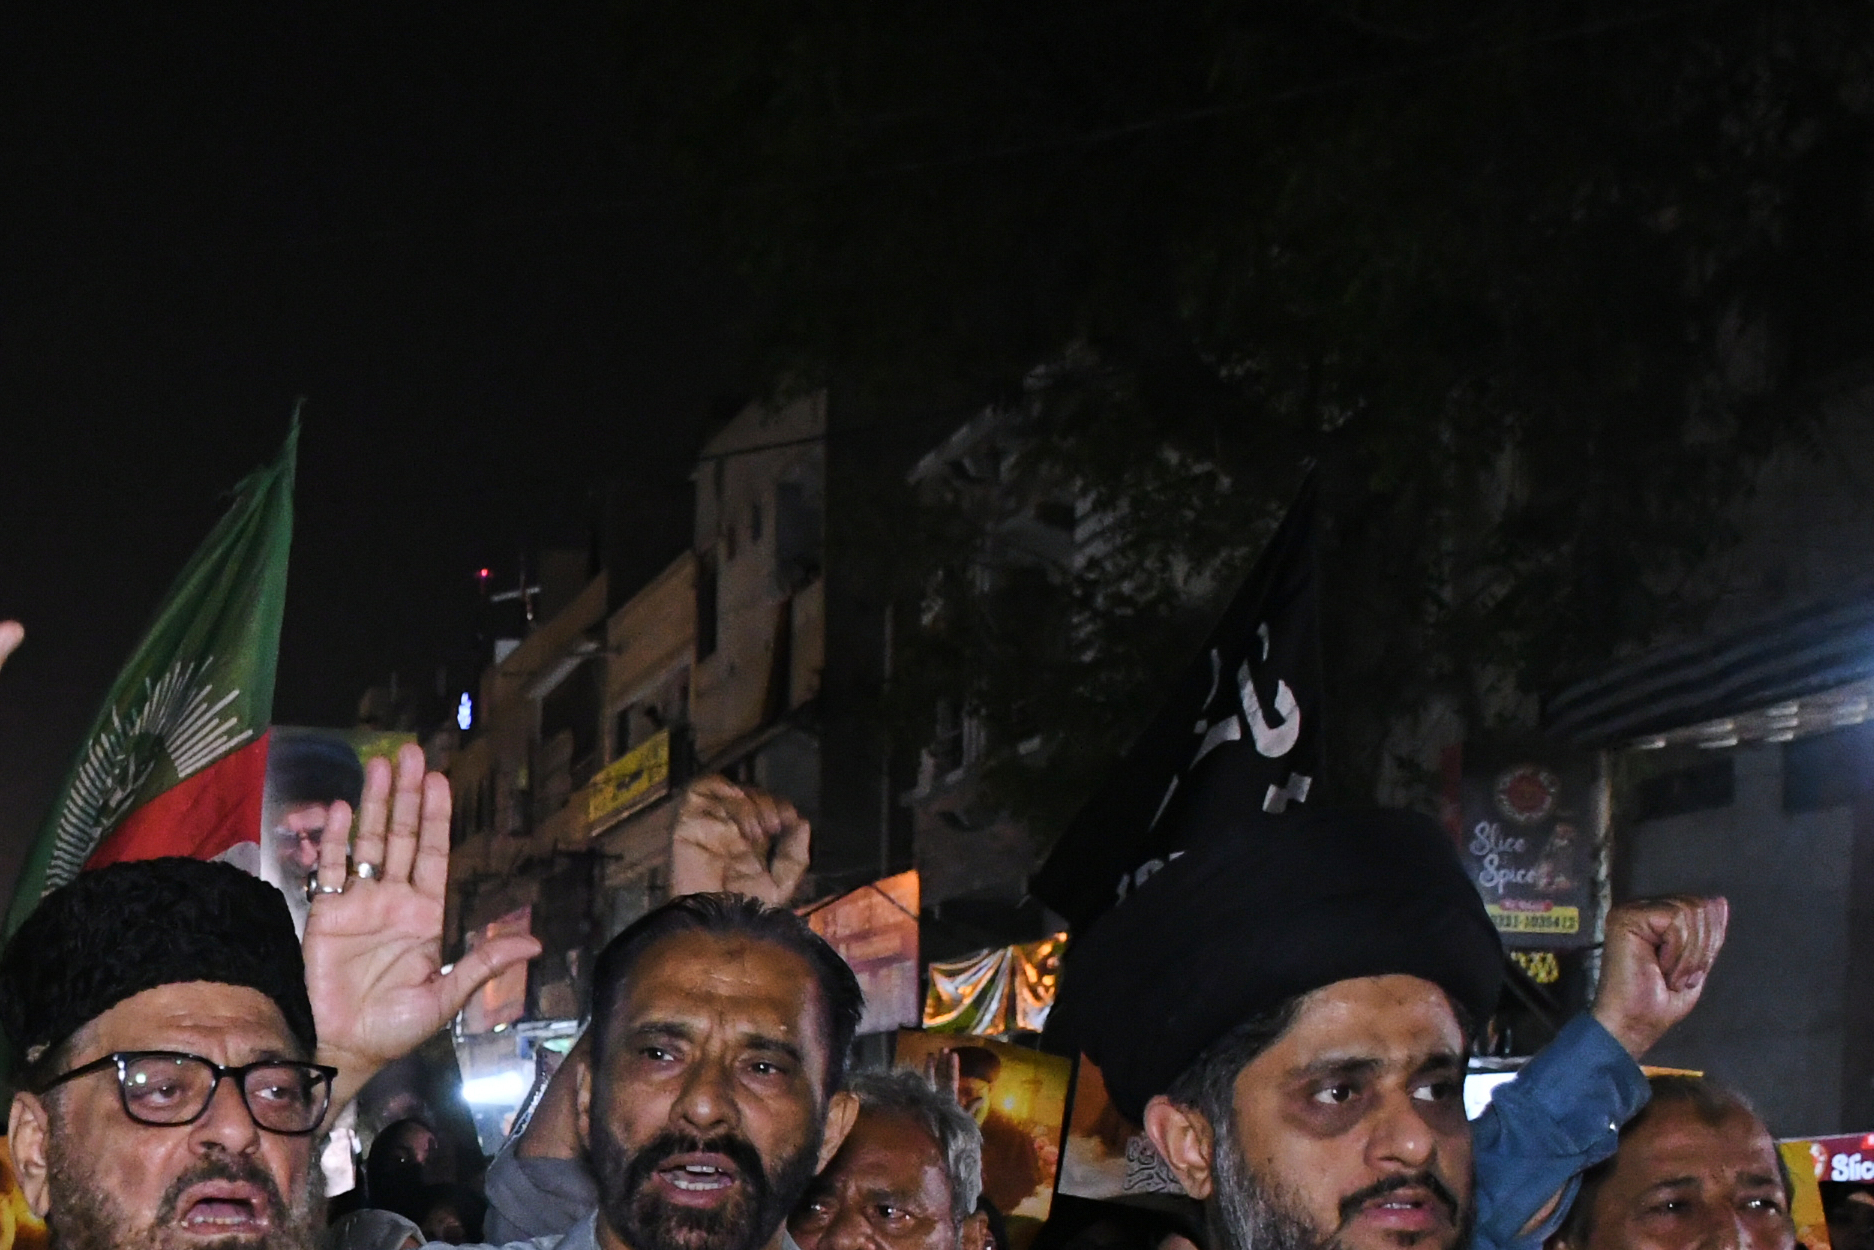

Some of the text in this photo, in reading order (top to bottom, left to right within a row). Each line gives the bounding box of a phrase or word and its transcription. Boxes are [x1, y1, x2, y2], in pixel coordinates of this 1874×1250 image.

[1470, 820, 1525, 856] Slice
[1479, 853, 1537, 894] Spice
[1831, 1153, 1874, 1182] Slic
